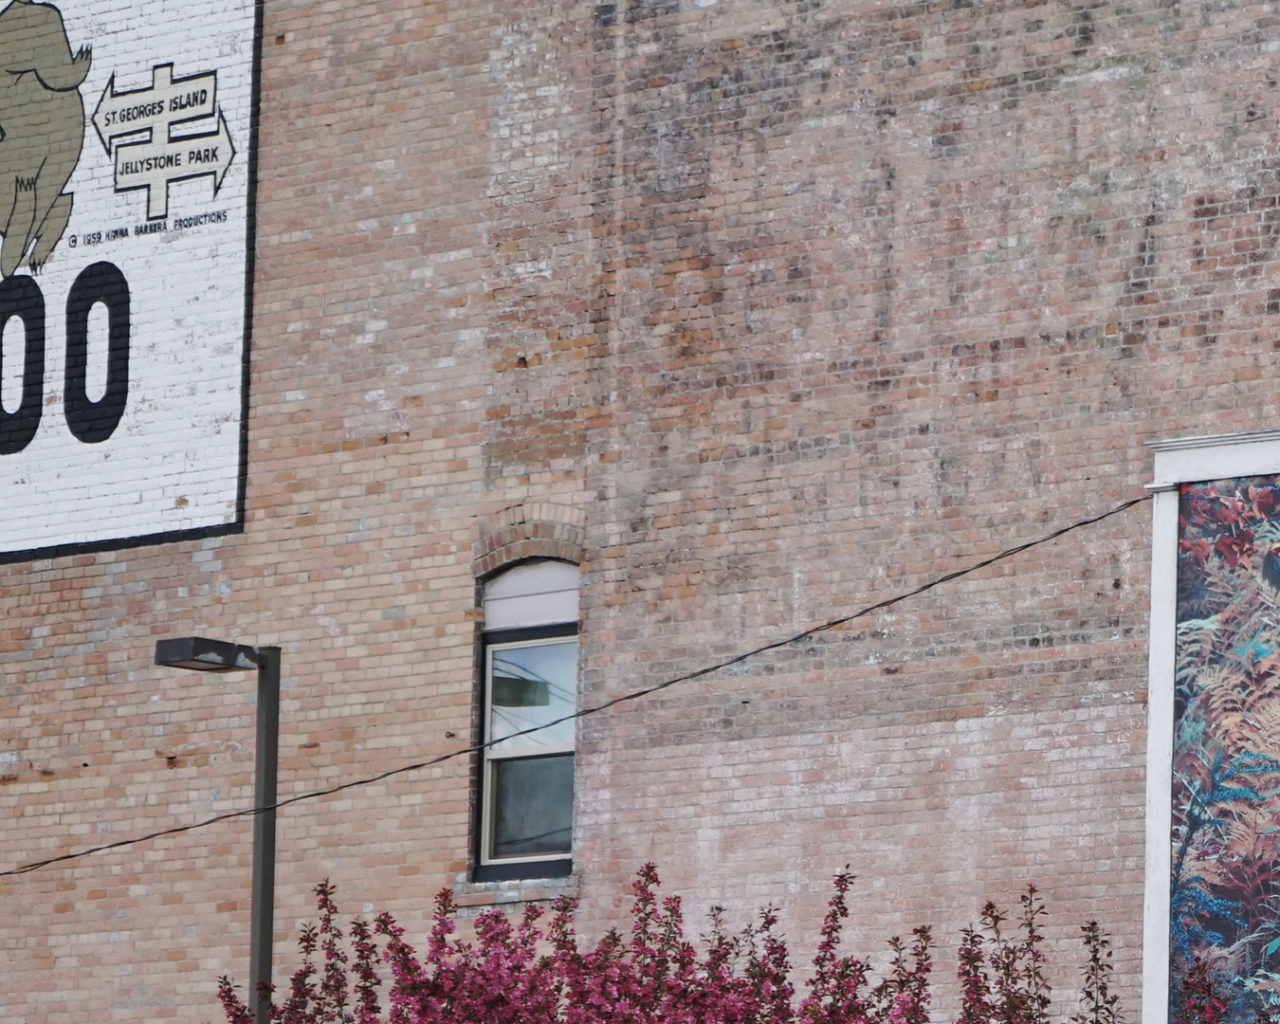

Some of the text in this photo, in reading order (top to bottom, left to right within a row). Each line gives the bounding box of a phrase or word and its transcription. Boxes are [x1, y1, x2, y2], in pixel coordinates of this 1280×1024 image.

[170, 89, 207, 112] ISLAND
[119, 147, 219, 175] JELLYSTONE PARK
[83, 233, 101, 245] 1959
[174, 211, 227, 229] PRODUCTIONS
